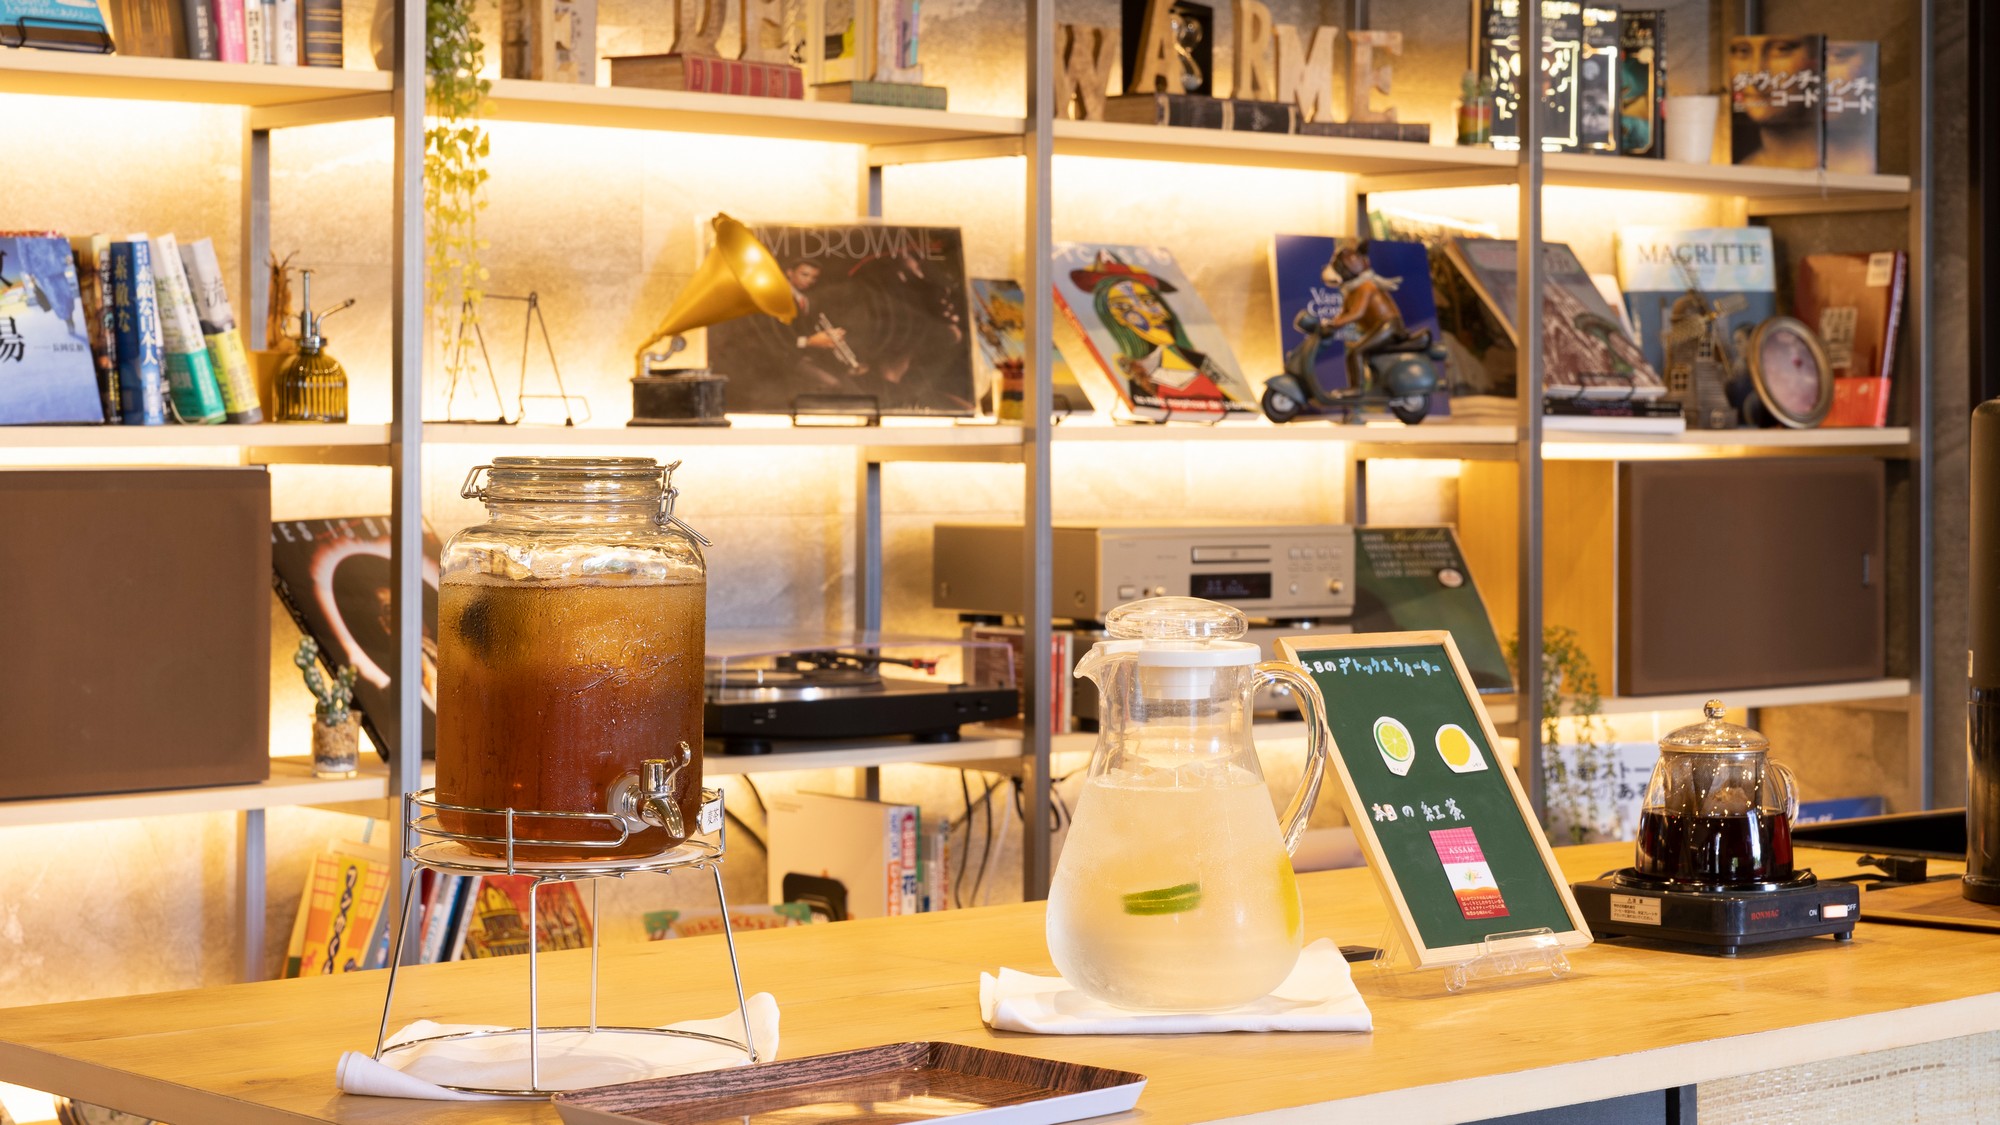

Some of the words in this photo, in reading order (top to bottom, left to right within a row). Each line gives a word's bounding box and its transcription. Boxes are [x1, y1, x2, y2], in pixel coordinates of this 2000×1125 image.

[1771, 88, 1820, 108] コード
[802, 225, 947, 261] BROWNE
[1638, 242, 1763, 265] MAGRITTE
[1449, 846, 1476, 855] ASSAM
[1847, 904, 1856, 912] OFF
